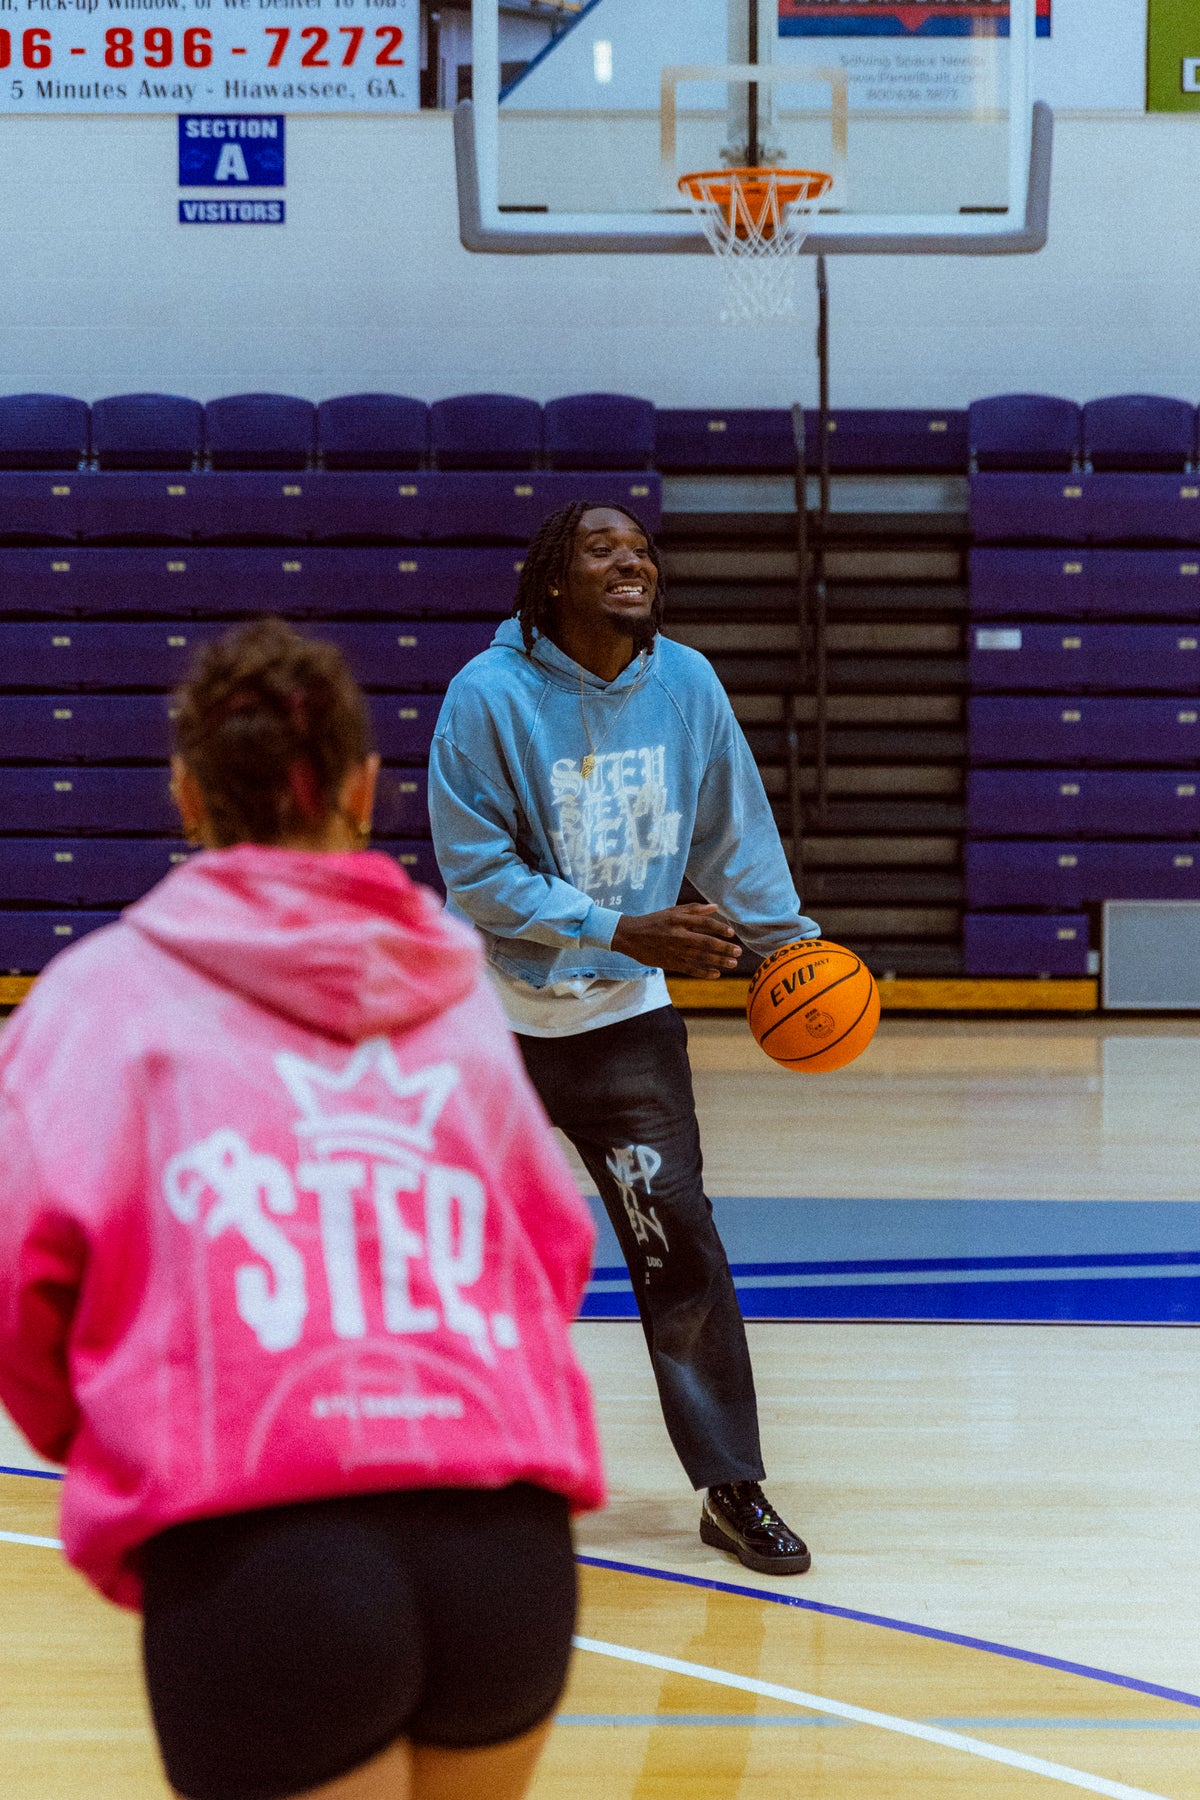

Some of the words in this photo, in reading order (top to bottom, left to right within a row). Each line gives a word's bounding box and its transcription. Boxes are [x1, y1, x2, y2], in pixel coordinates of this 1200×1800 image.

[264, 26, 405, 68] 7272
[10, 80, 24, 99] 5
[36, 80, 127, 99] Minutes
[138, 79, 197, 102] Away
[224, 79, 356, 99] Hiawassee,
[184, 119, 278, 139] SECTION
[213, 142, 249, 181] A
[182, 201, 281, 221] VISITORS
[769, 964, 815, 1008] EVO
